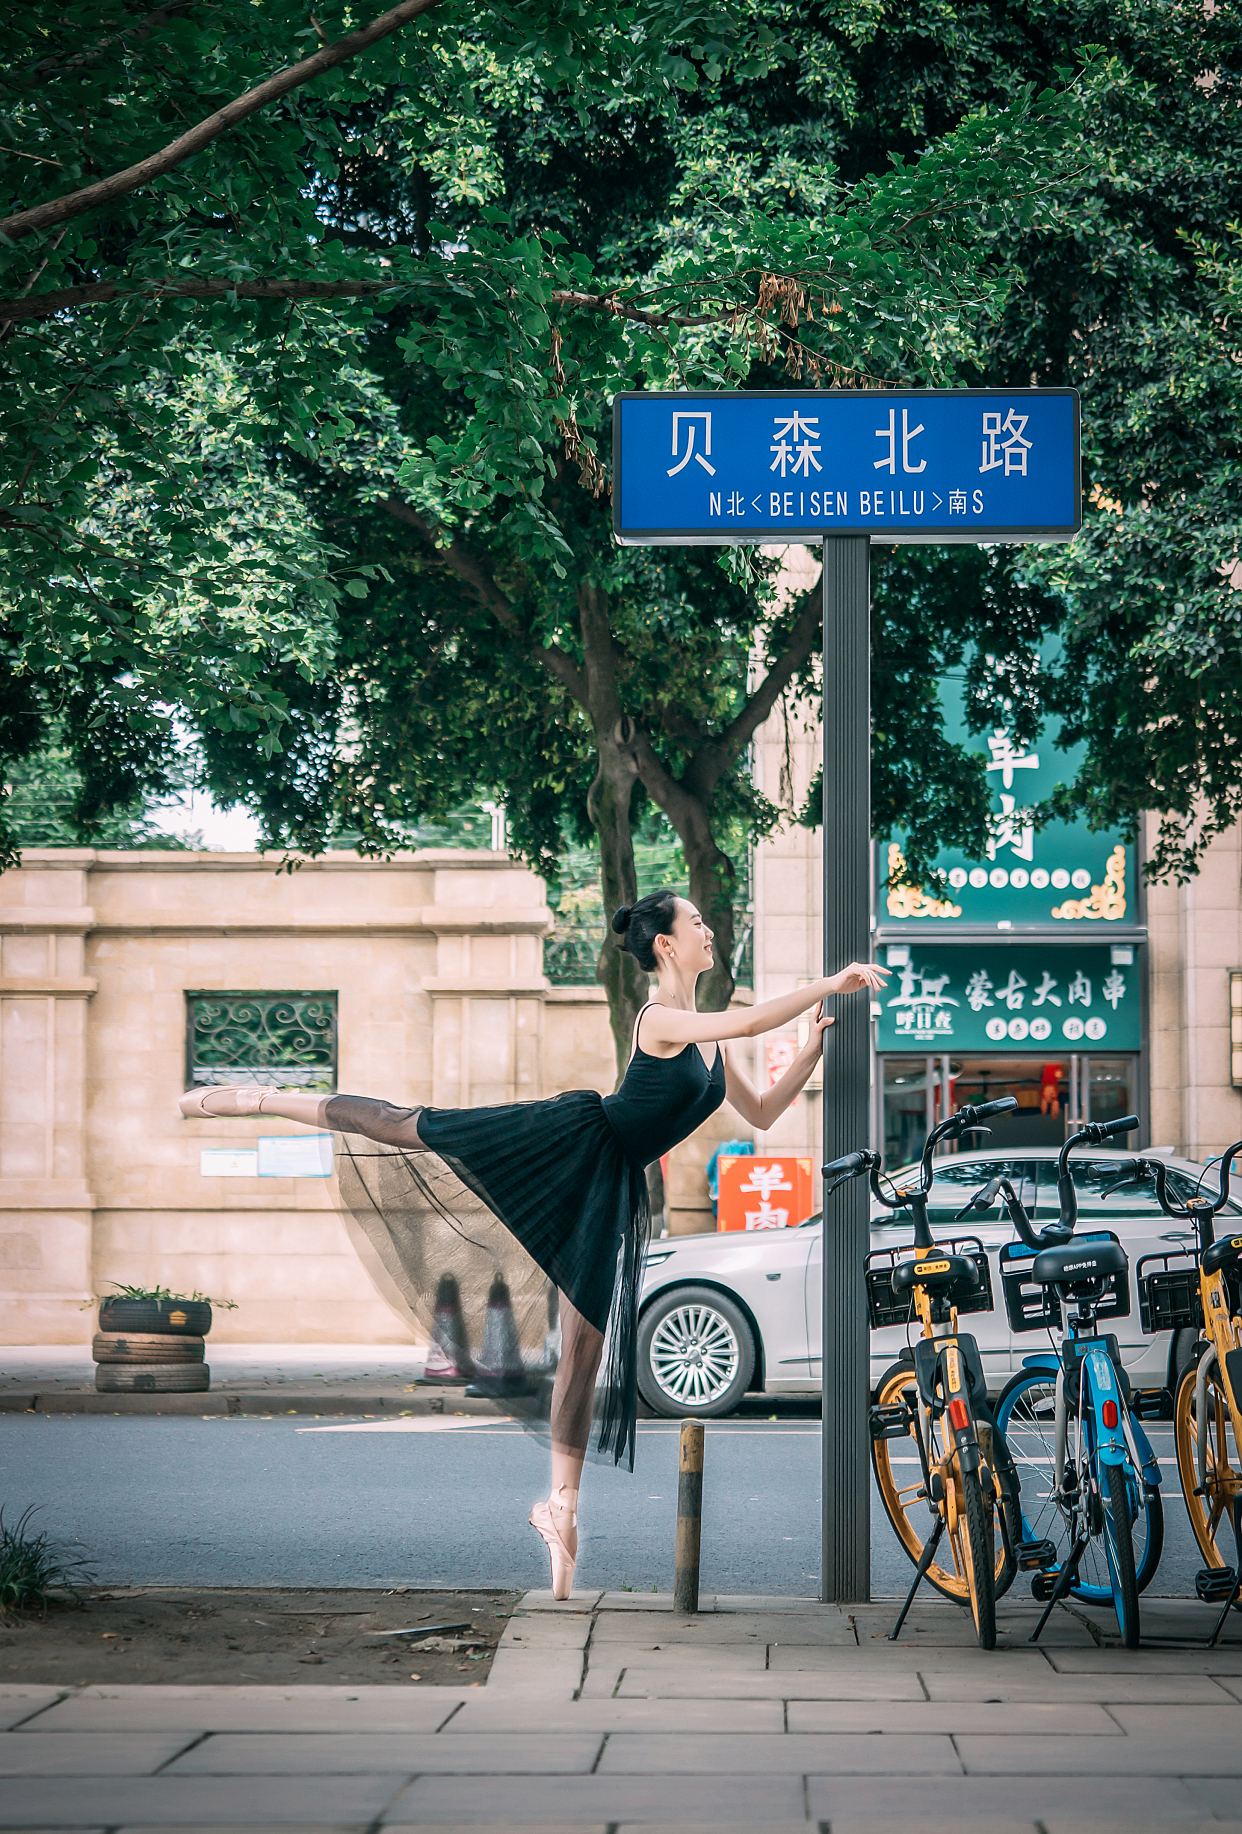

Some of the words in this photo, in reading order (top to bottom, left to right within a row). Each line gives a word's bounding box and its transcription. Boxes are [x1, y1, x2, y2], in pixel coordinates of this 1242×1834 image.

[666, 407, 1034, 478] 贝森北路
[770, 491, 848, 517] BEISEN
[860, 490, 925, 516] BEILU
[965, 968, 1127, 1011] 蒙古大肉串
[739, 1163, 793, 1230] 羊肉
